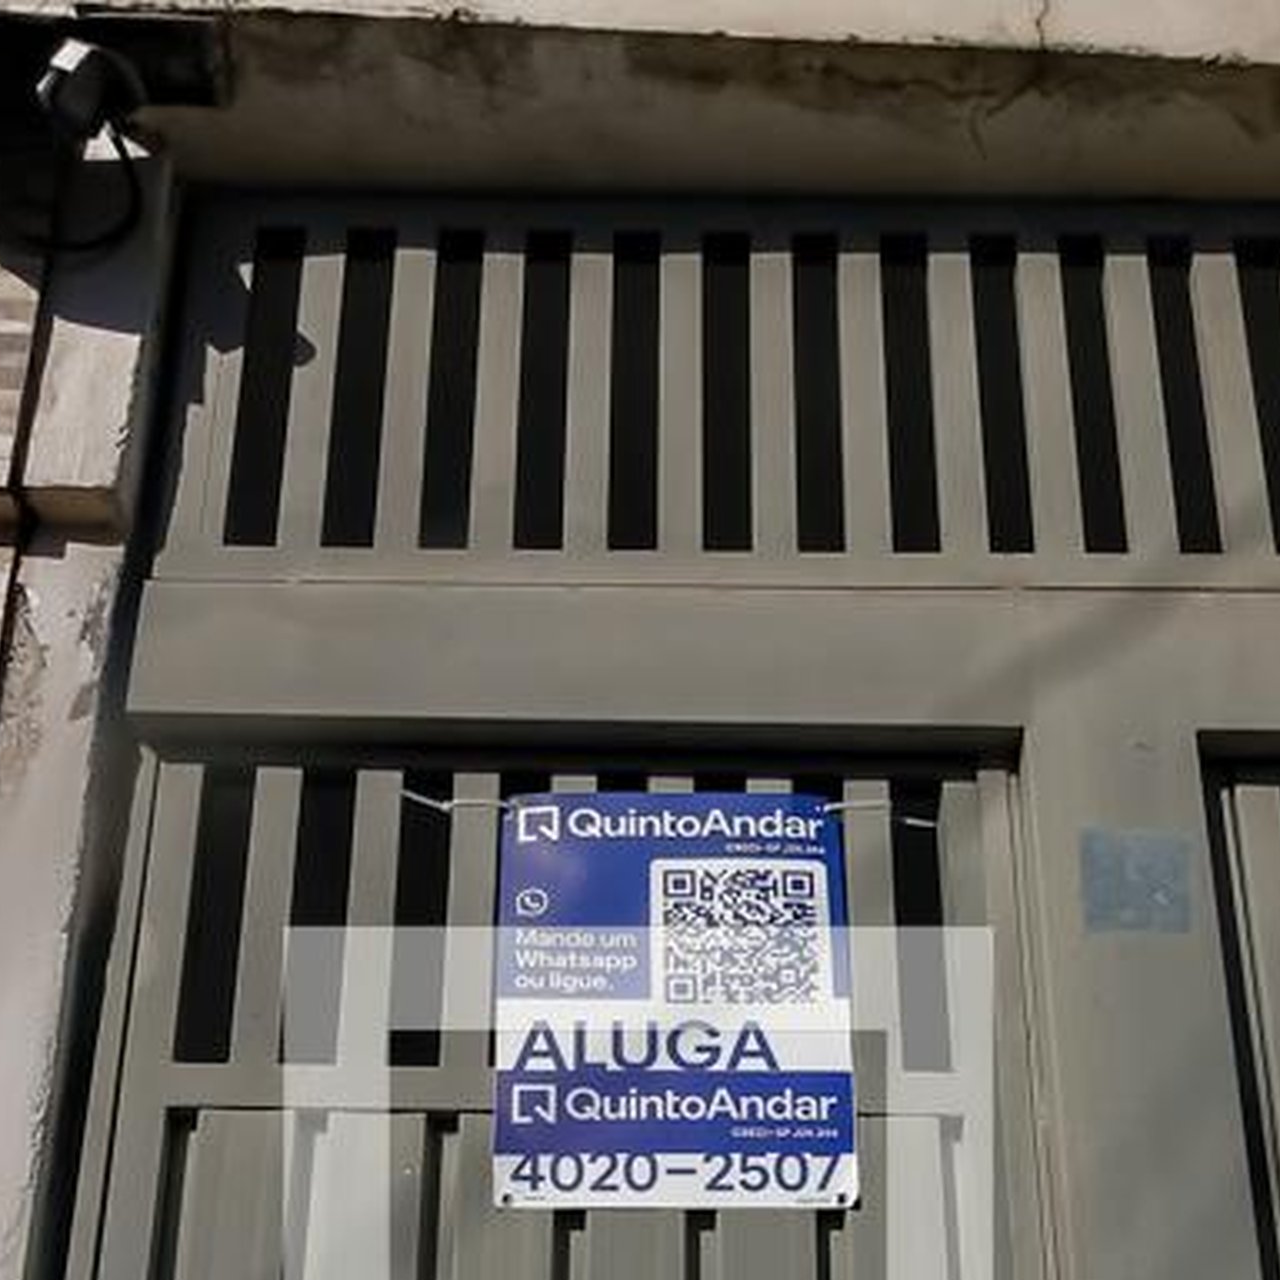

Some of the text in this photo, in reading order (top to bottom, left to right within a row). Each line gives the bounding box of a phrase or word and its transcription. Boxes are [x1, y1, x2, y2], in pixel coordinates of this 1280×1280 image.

[568, 808, 824, 840] QuintoAndar
[599, 932, 637, 948] um
[515, 974, 545, 989] ou
[513, 1019, 781, 1071] ALUGA
[566, 1086, 837, 1122] QuintoAndar
[510, 1153, 840, 1192] 4020-2507
